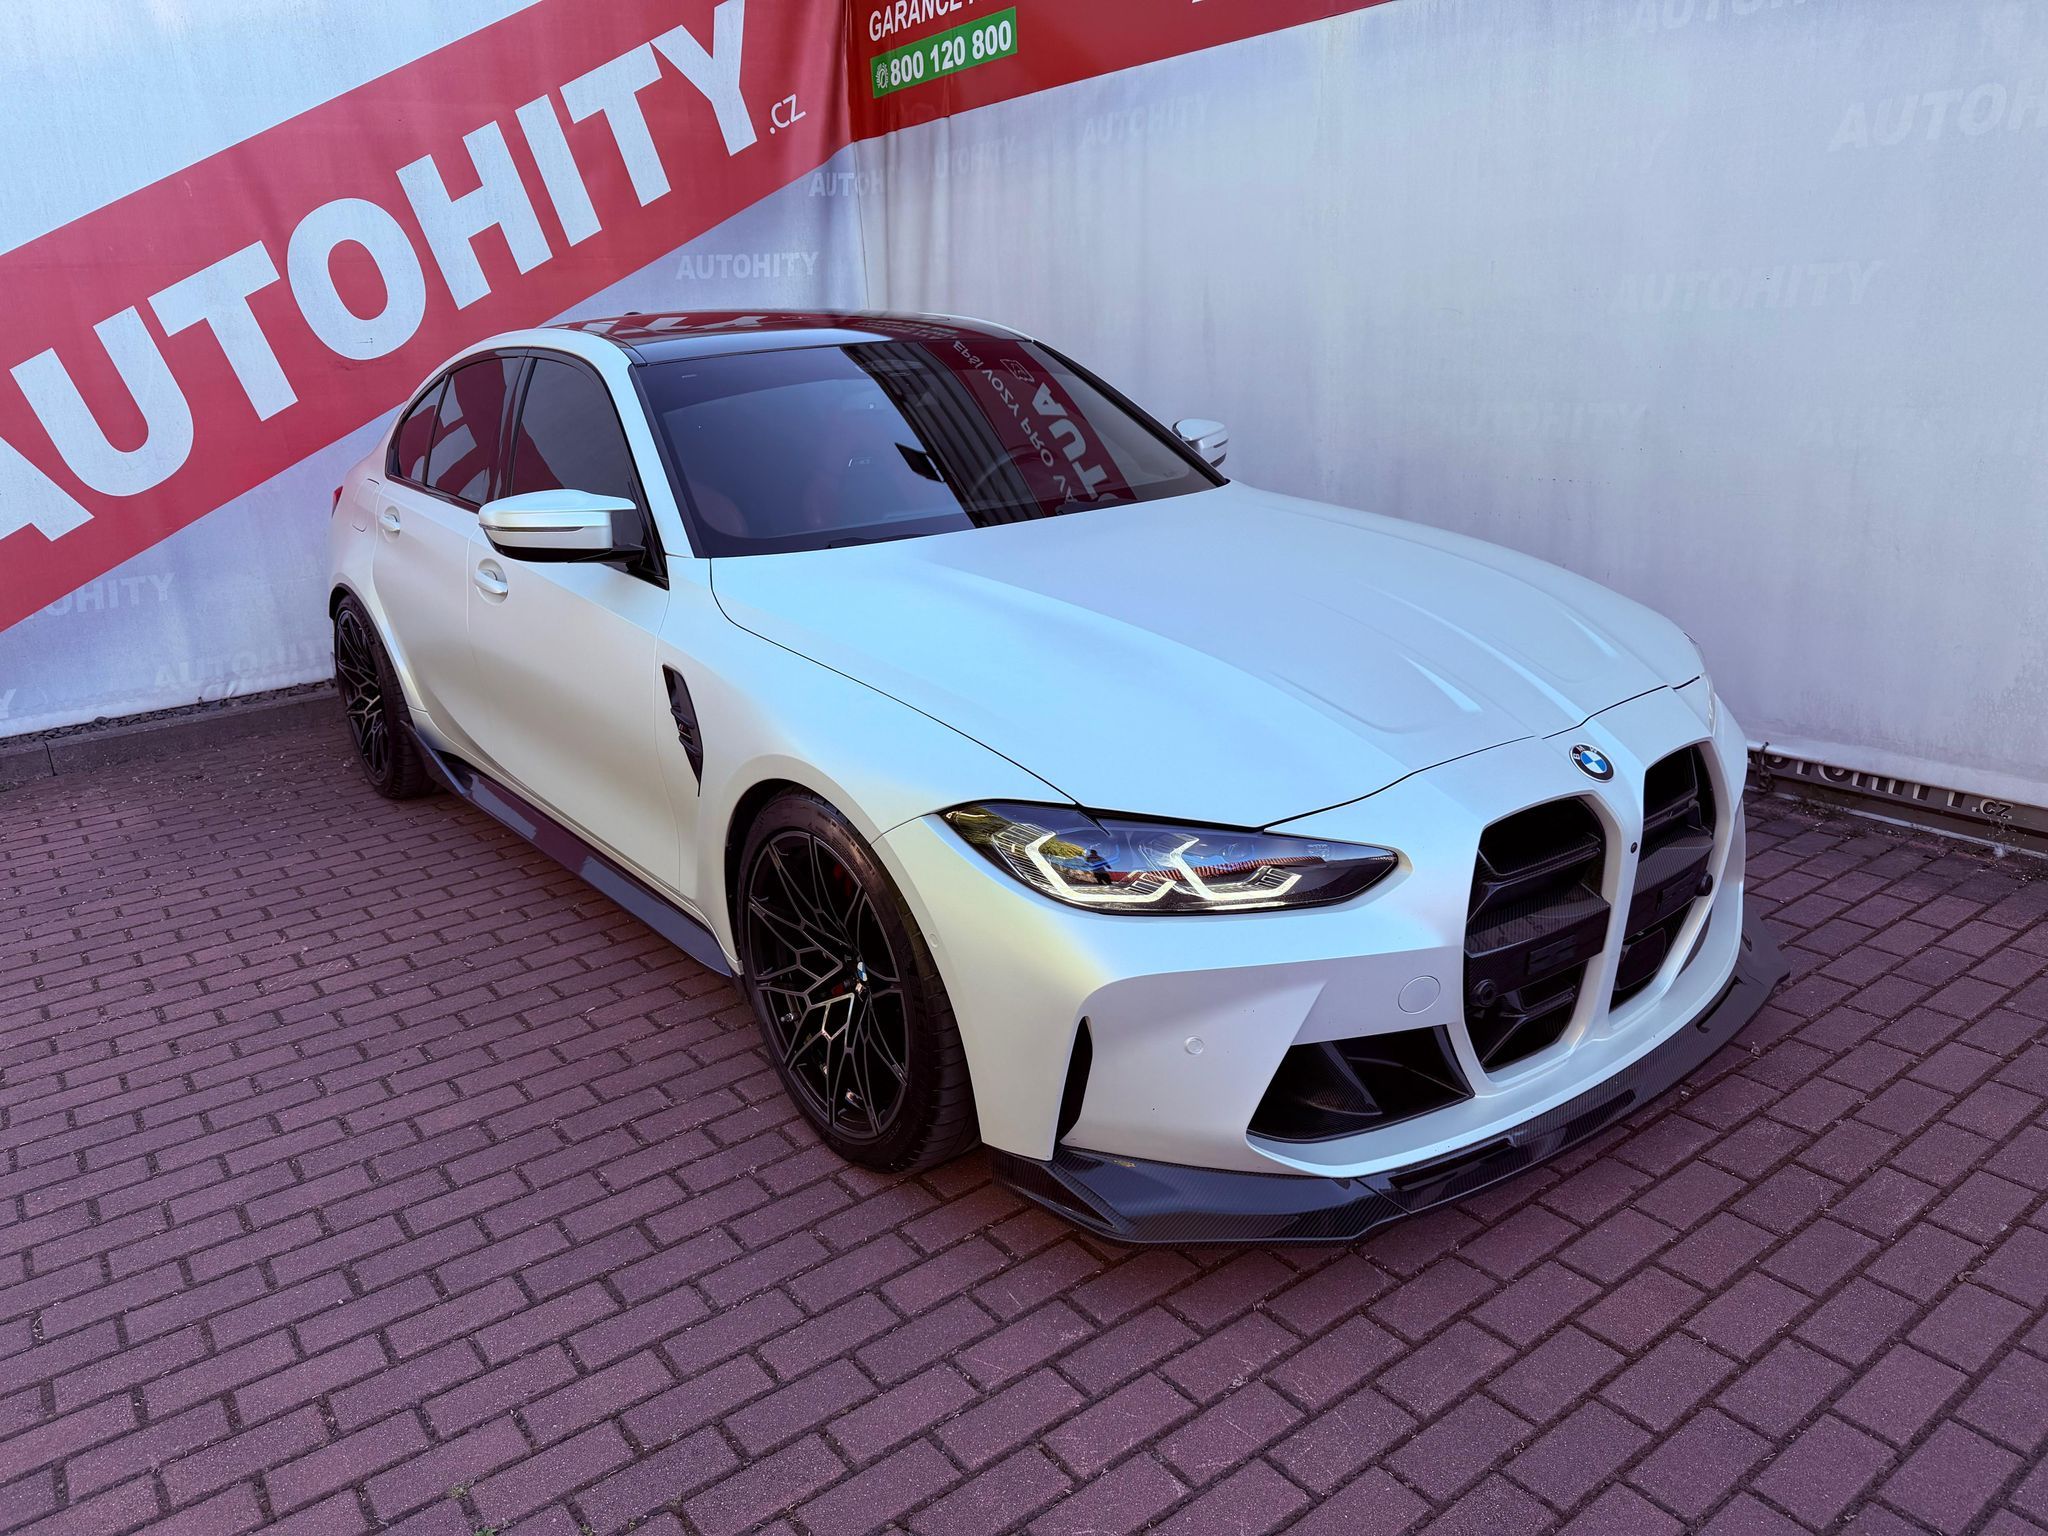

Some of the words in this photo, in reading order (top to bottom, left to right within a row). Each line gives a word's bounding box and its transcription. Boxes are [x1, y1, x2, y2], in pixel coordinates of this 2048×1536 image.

[890, 50, 924, 87] 800
[930, 36, 966, 73] 120
[972, 20, 1012, 61] 800
[675, 251, 819, 280] AUTOHITY
